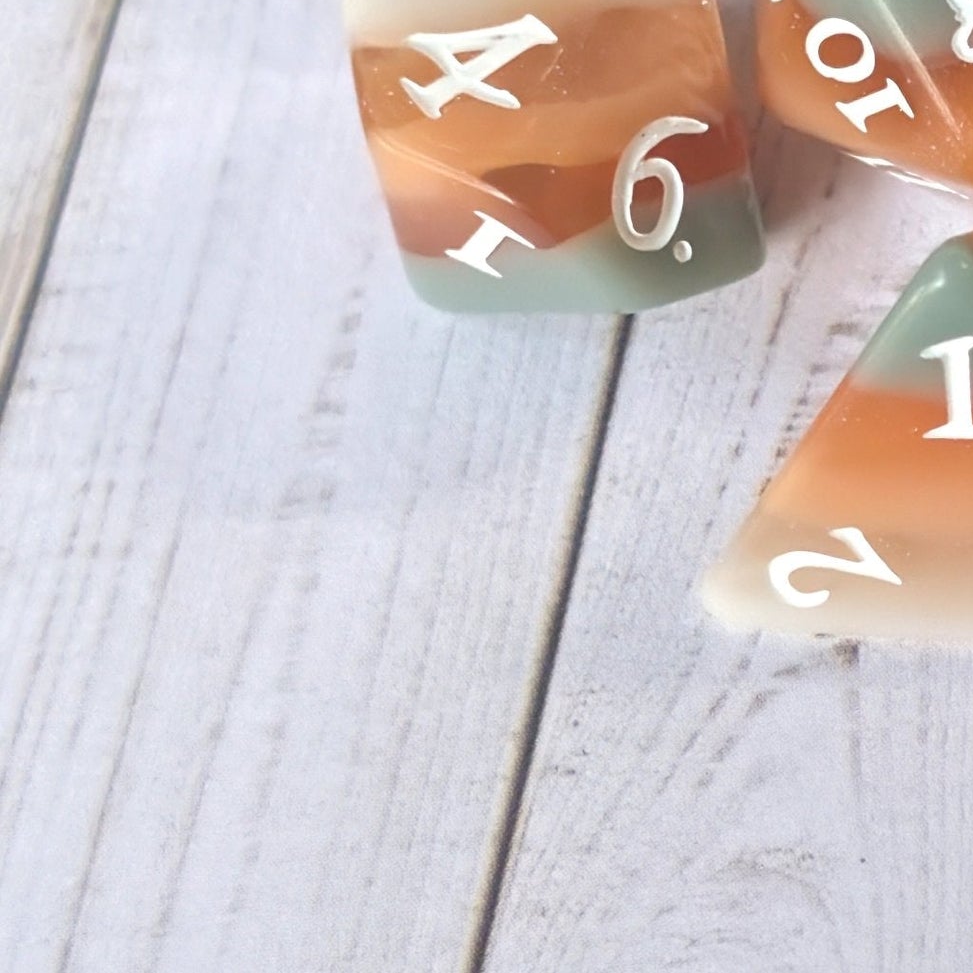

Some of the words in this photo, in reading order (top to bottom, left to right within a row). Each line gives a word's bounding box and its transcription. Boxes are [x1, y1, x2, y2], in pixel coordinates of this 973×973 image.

[399, 13, 559, 120] 4
[804, 16, 916, 134] 10
[444, 210, 537, 278] 1
[767, 526, 903, 609] 2
